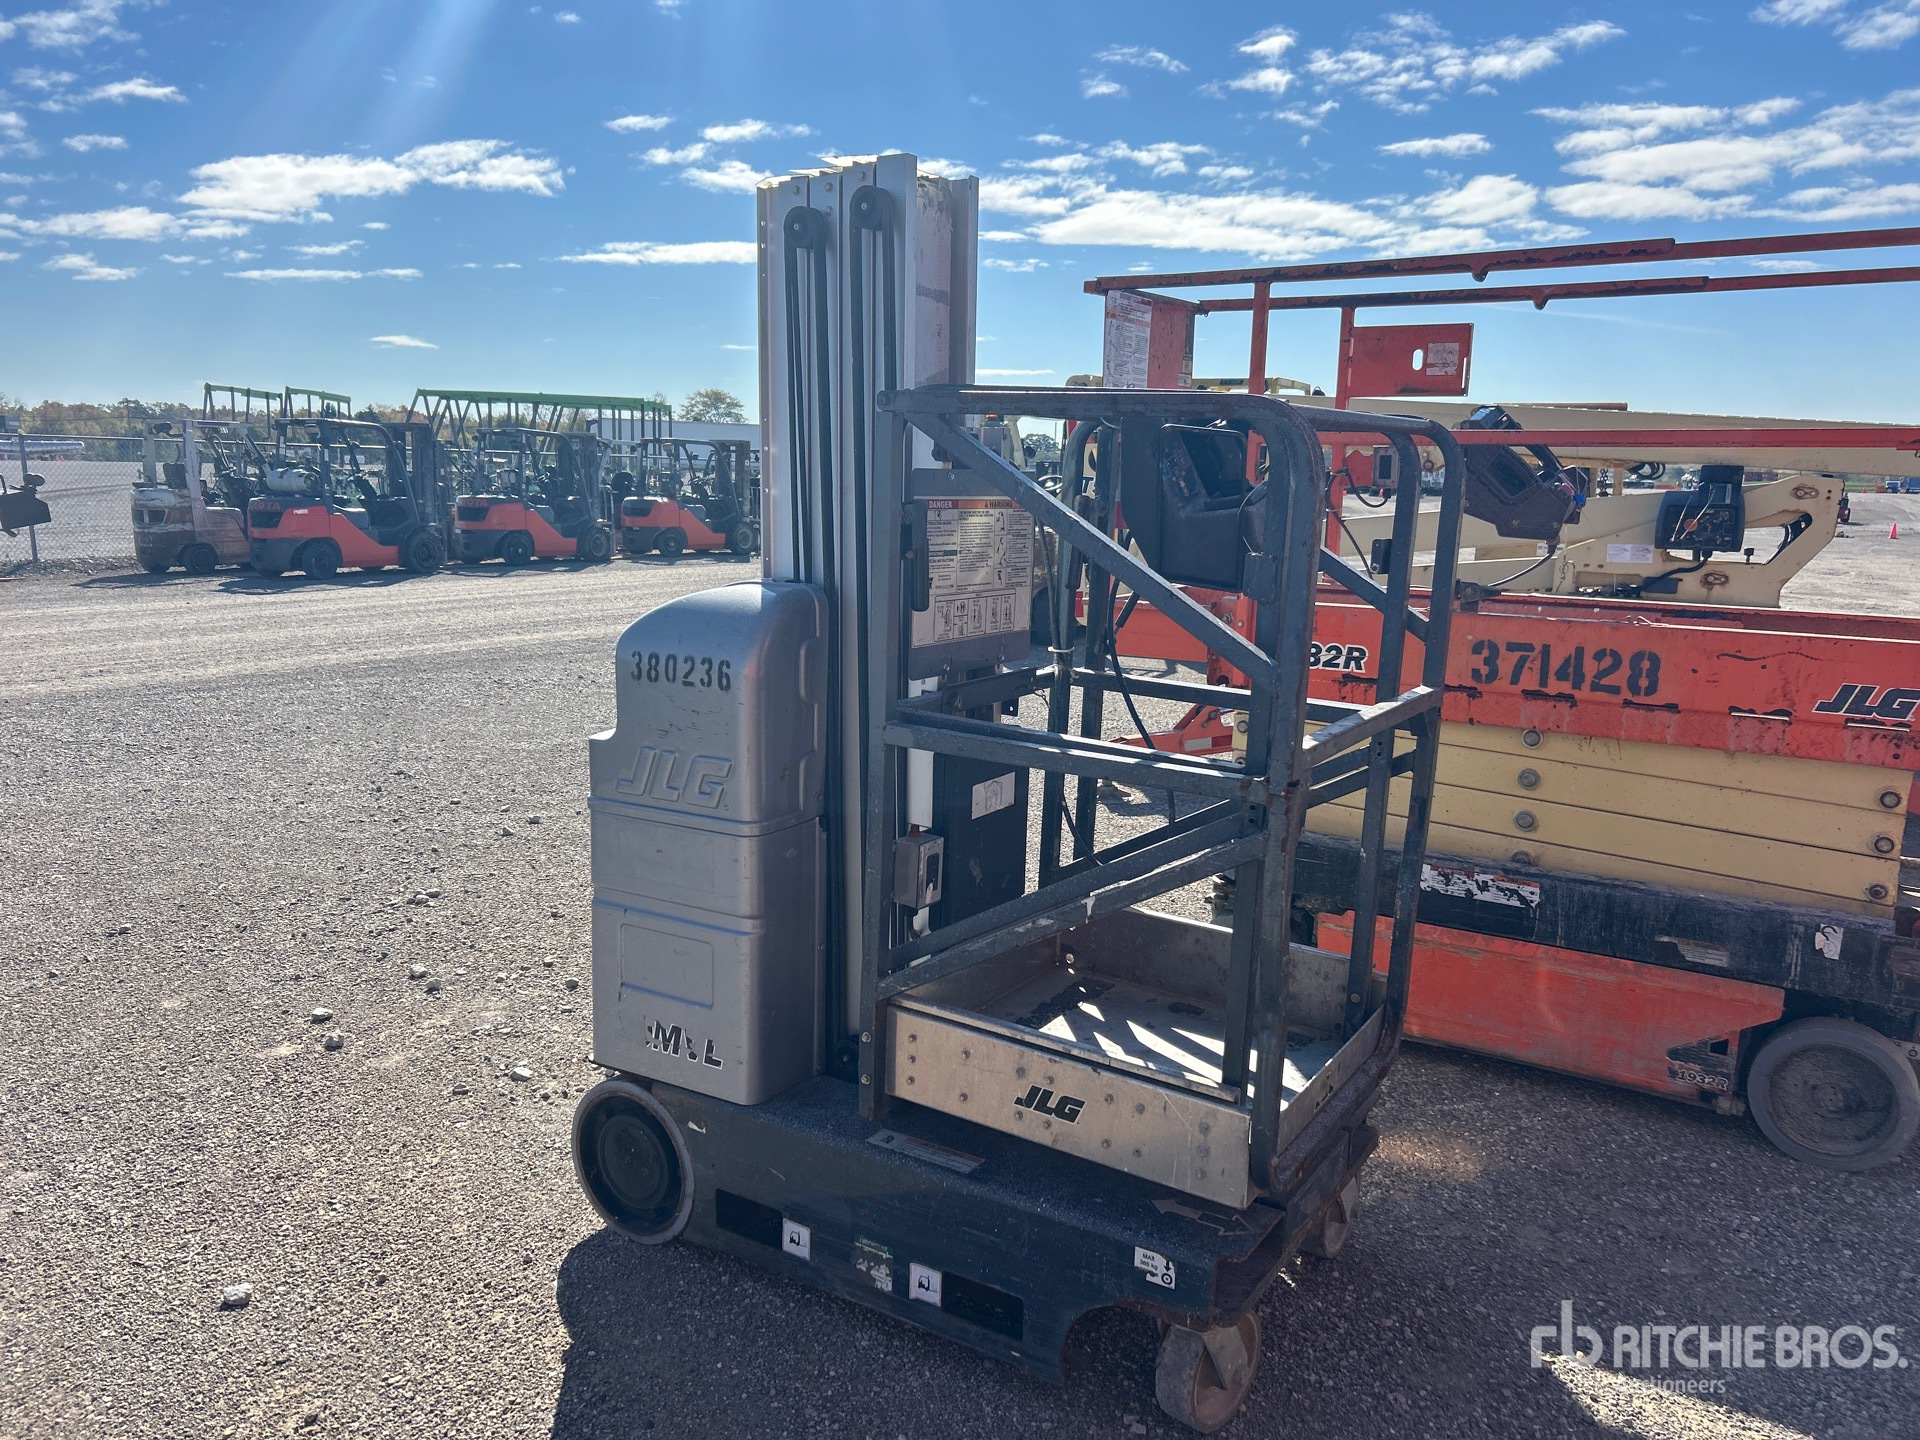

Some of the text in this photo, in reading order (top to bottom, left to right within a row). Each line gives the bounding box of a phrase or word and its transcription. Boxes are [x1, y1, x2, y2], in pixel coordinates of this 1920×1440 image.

[928, 500, 952, 509] DANGER
[989, 500, 1012, 508] WARNING
[630, 650, 731, 692] 380236
[1471, 639, 1661, 697] 371428
[1812, 683, 1920, 720] JLG
[614, 745, 734, 810] JLG
[1676, 1069, 1729, 1091] 1932R
[1013, 1084, 1087, 1124] JLG
[1142, 1252, 1155, 1262] MAX
